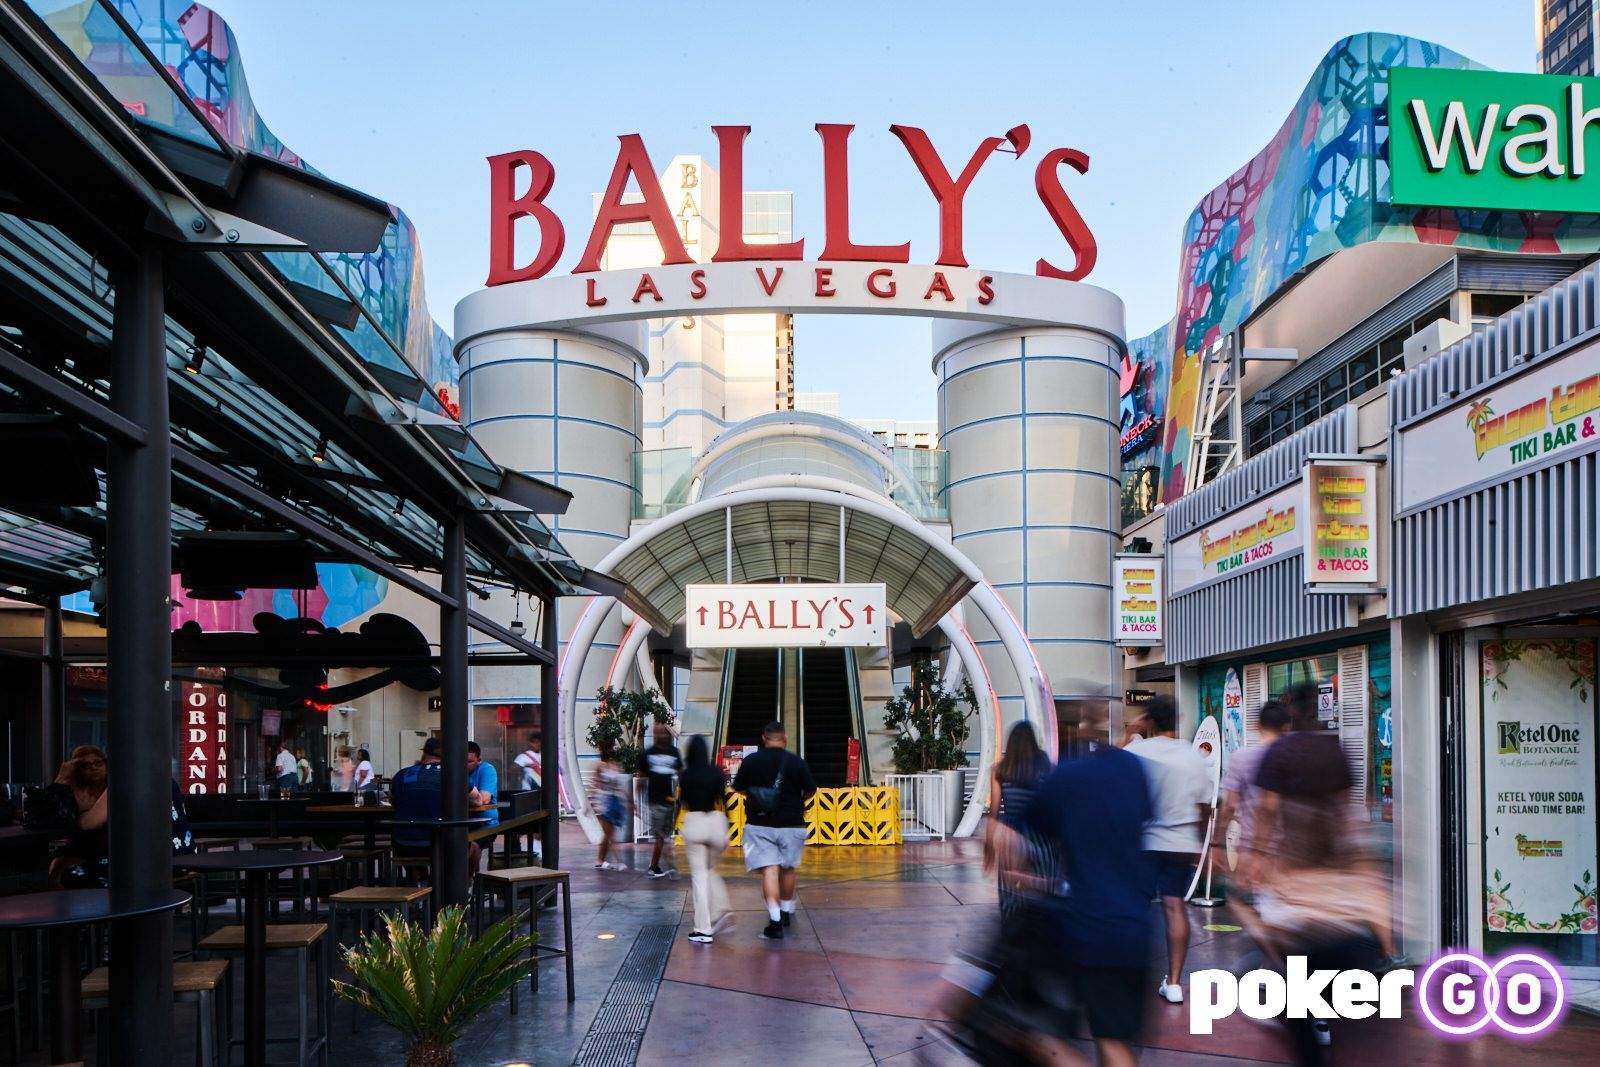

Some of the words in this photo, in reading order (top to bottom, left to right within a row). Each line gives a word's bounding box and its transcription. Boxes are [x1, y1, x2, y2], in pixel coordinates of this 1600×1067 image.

[485, 122, 1097, 286] BALLY'S
[586, 269, 707, 306] LAS
[755, 267, 995, 305] VEGAS
[1509, 436, 1538, 465] TIKI
[1543, 422, 1577, 453] BAR
[1581, 416, 1596, 438] &
[1216, 558, 1229, 574] TIKI
[1230, 553, 1243, 569] BAR
[1244, 550, 1250, 564] &
[1251, 541, 1273, 561] TACOS
[1343, 547, 1368, 558] BAR
[1317, 559, 1327, 571] &
[1329, 559, 1369, 571] TACOS
[717, 596, 856, 630] BALLY'S
[1121, 615, 1137, 624] TIKI
[1139, 615, 1156, 624] BAR
[1121, 623, 1128, 632] &
[1131, 623, 1157, 632] TACOS
[1498, 722, 1546, 751] Ketel
[1547, 724, 1580, 743] One
[1523, 746, 1580, 754] BOTANICAL
[1498, 791, 1526, 802] KETEL
[1529, 791, 1555, 802] YOUR
[1558, 791, 1585, 802] SODA
[1497, 805, 1506, 815] AT
[1509, 805, 1540, 814] ISLAND
[1542, 805, 1563, 814] TIME
[1565, 805, 1585, 814] BAR!
